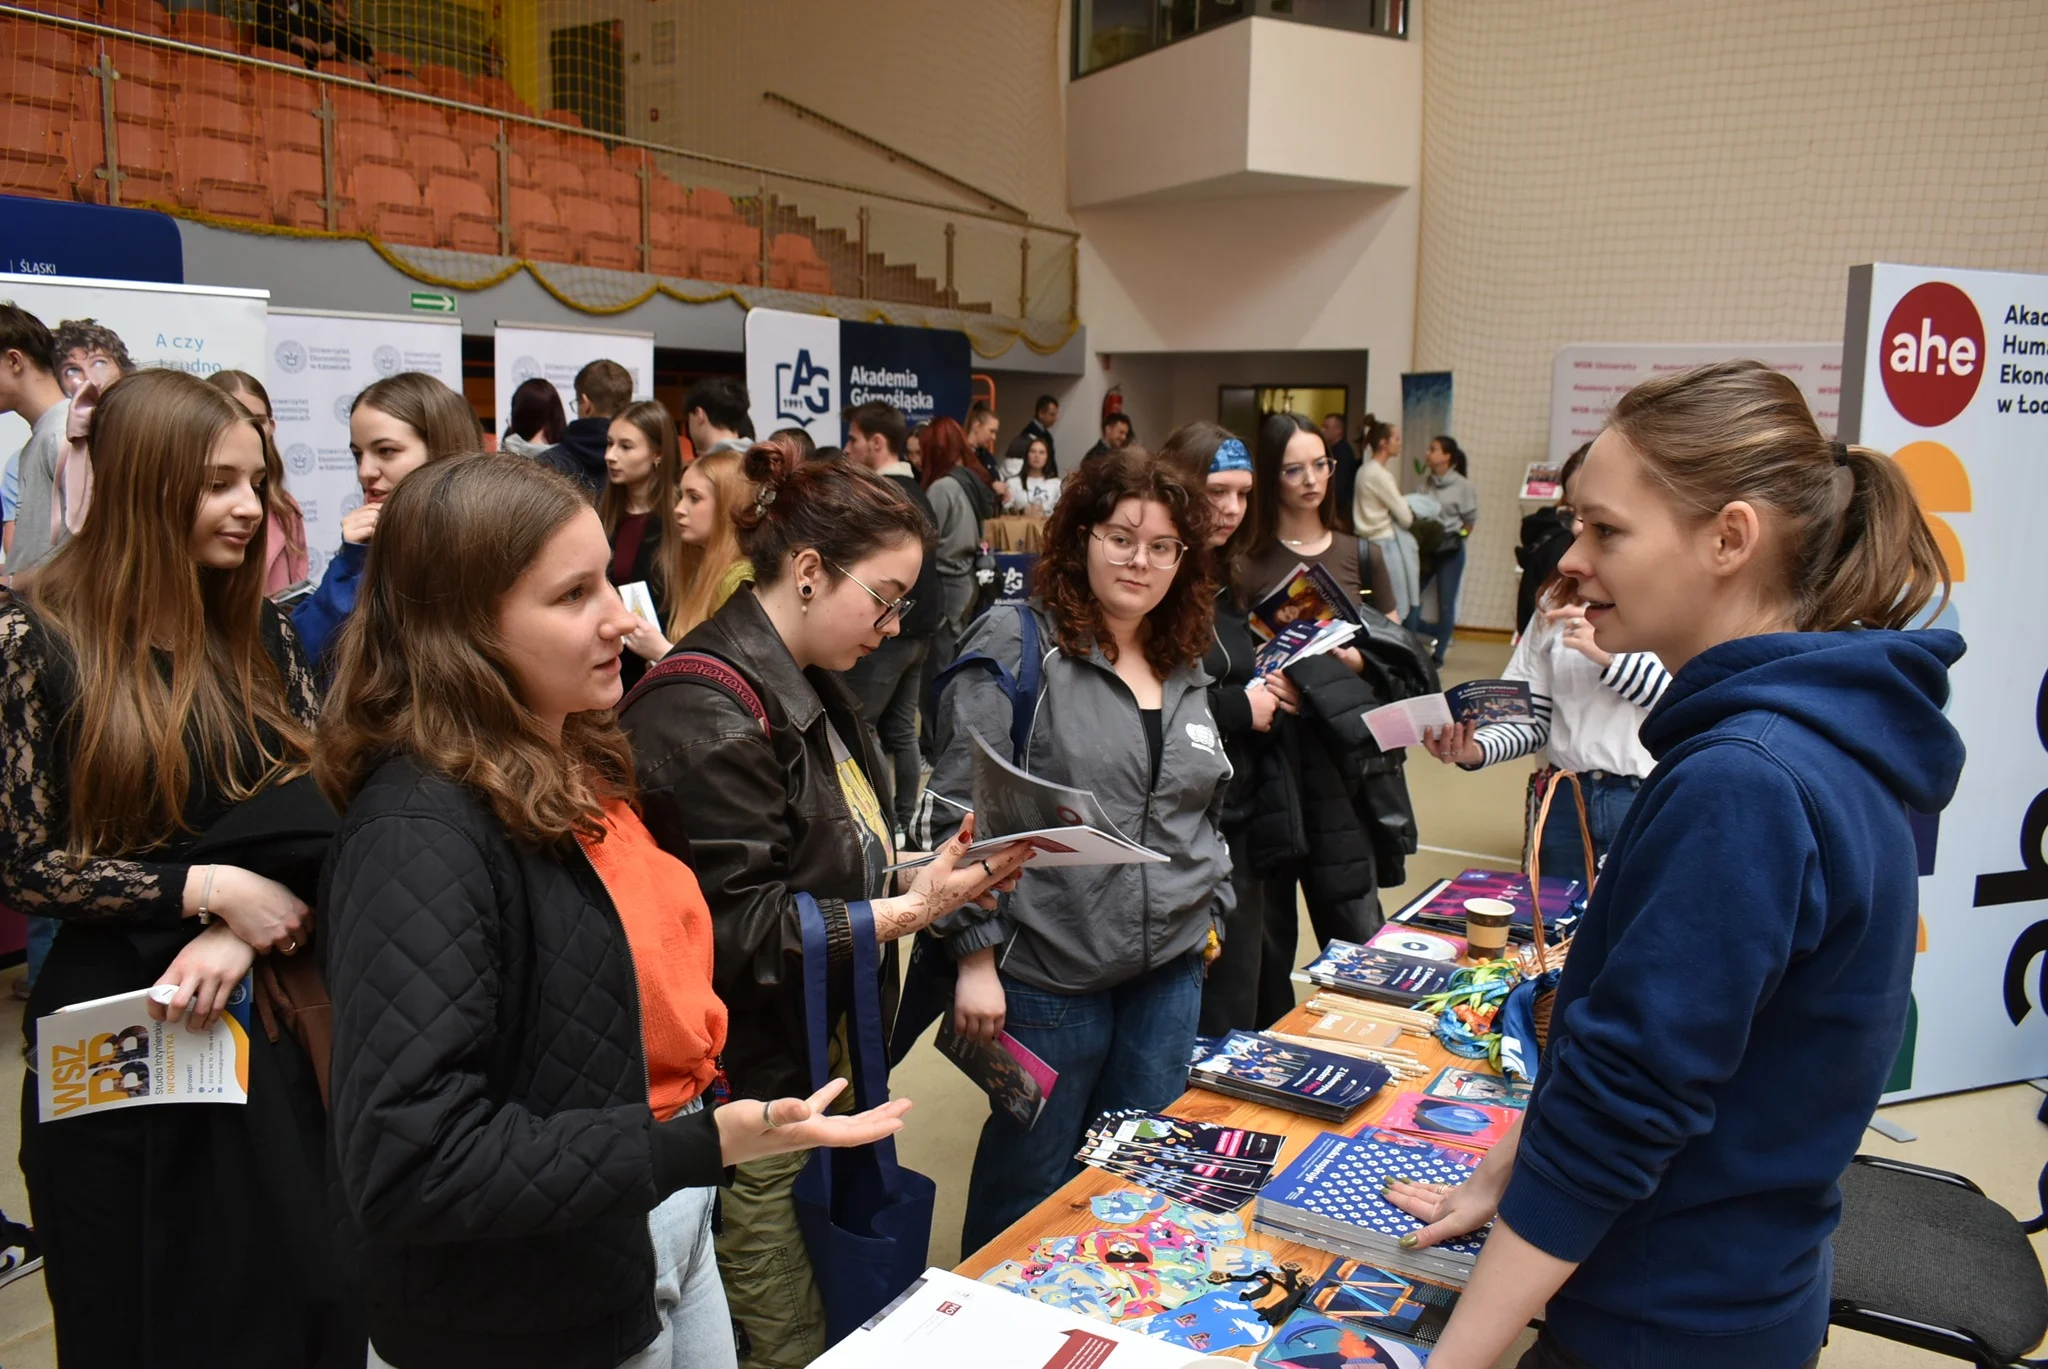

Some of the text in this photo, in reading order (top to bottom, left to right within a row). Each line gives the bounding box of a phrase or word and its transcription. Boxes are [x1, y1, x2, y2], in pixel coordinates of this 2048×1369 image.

[20, 259, 57, 275] ŚLĄSKI
[155, 333, 204, 352] A czy
[1890, 317, 1977, 377] ahe
[2002, 334, 2048, 356] Hum
[850, 365, 918, 389] Akademia
[850, 386, 934, 413] Górnośląska
[1997, 399, 2013, 413] w
[166, 1031, 175, 1095] INFORMATYKA
[52, 1039, 88, 1117] WSIZ
[155, 1067, 164, 1096] Studia
